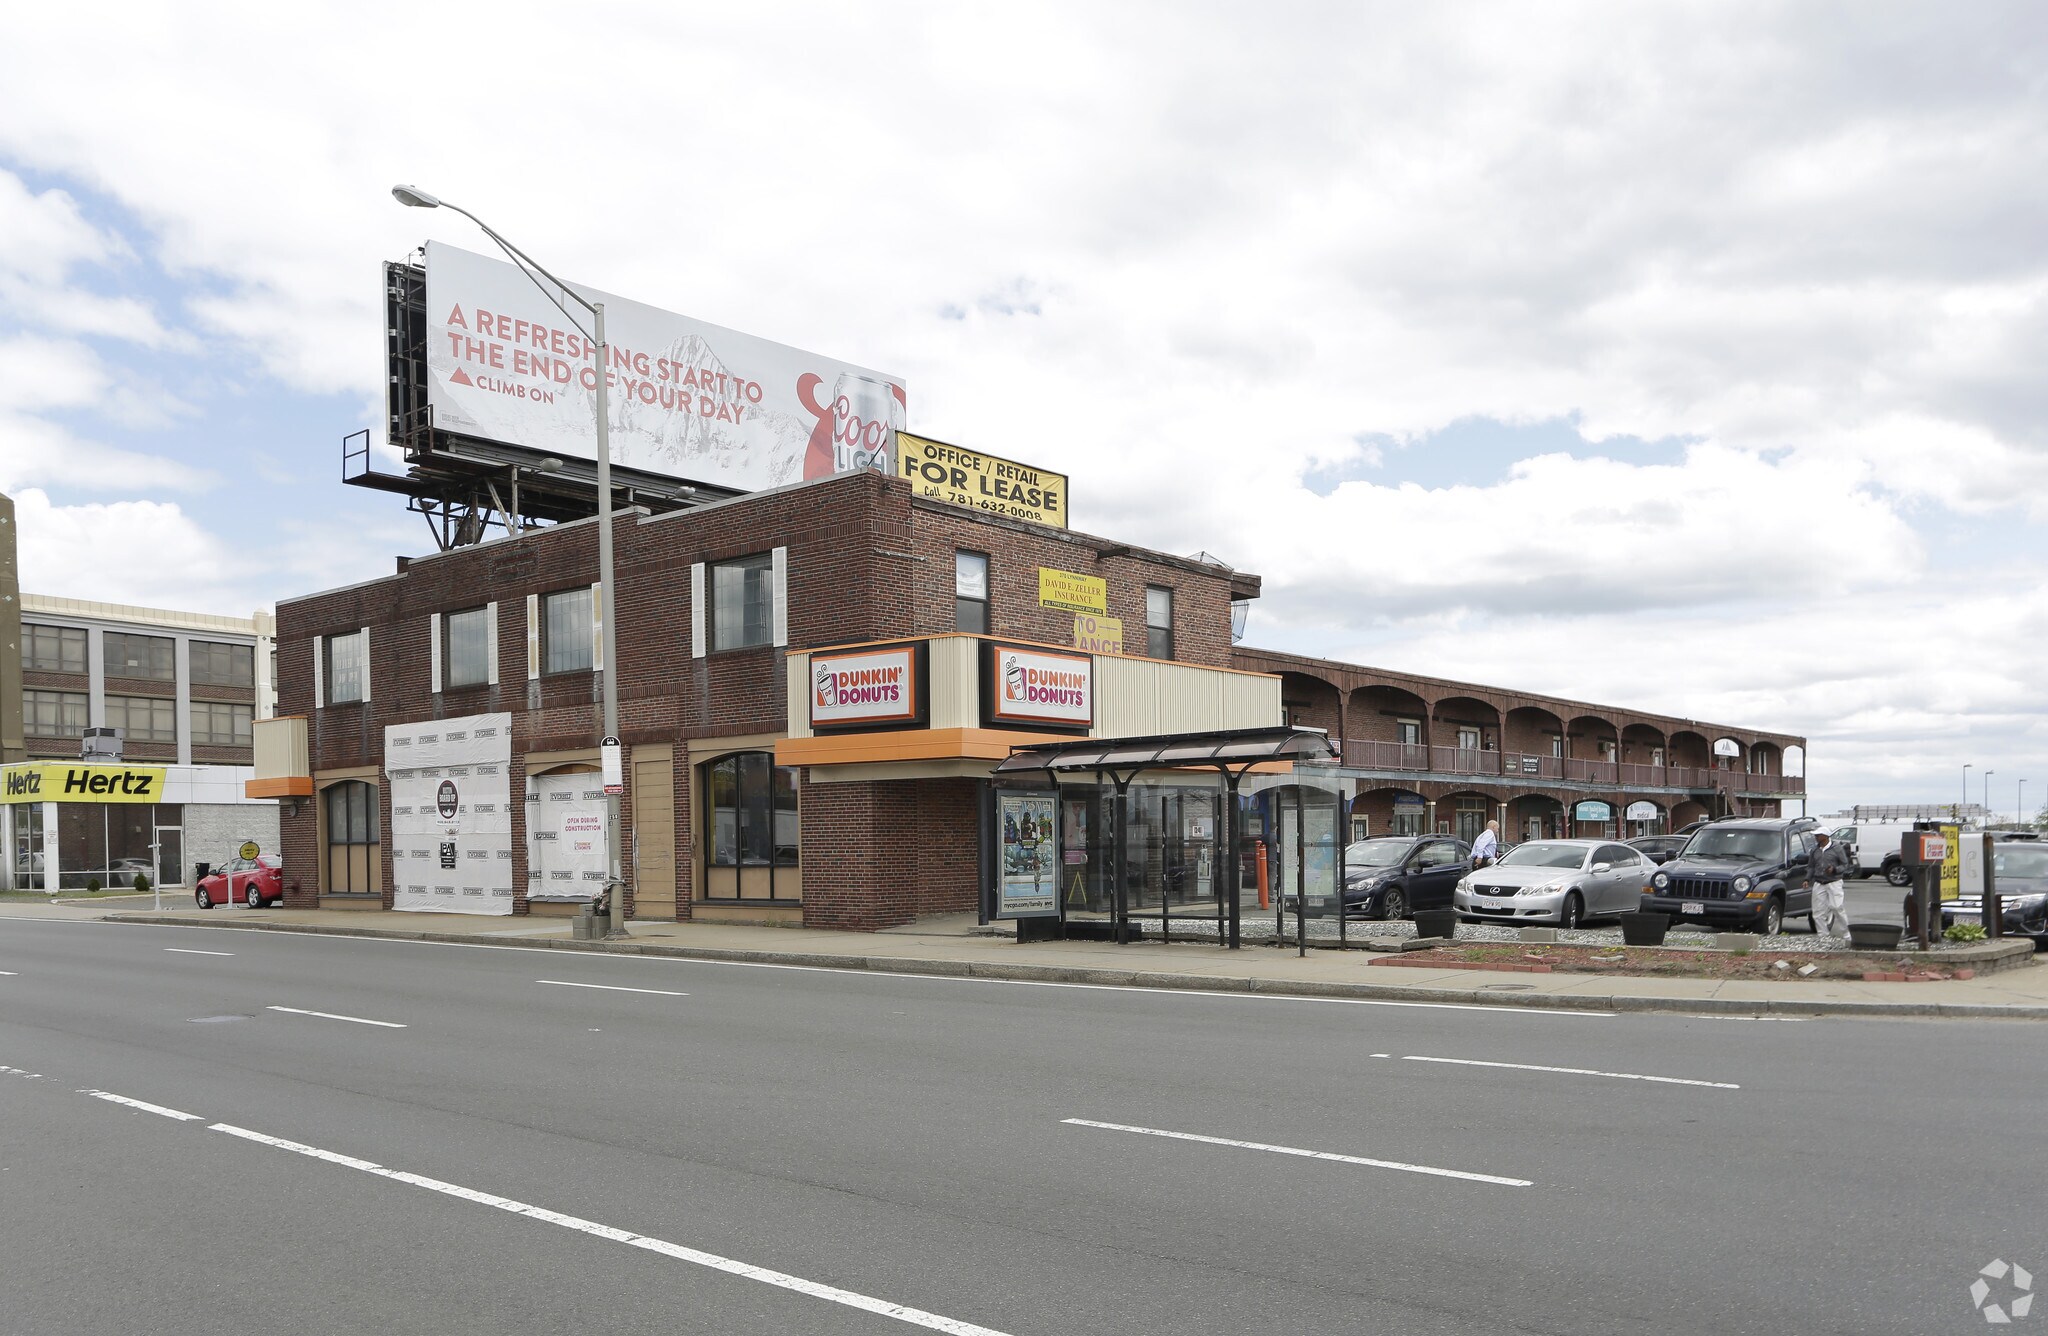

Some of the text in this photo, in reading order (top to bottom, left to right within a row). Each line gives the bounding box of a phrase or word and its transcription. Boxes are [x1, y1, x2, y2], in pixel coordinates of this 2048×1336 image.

[447, 303, 763, 404] A REFRESHING START TO
[447, 331, 504, 369] THE
[513, 349, 571, 384] END
[621, 376, 691, 414] YOUR
[700, 395, 744, 425] DAY
[476, 375, 554, 405] CLIMB ON
[838, 446, 885, 473] LIGH
[923, 445, 980, 471] OFFICE
[997, 462, 1039, 487] RETAIL
[905, 455, 1057, 512] FOR LEASE
[924, 485, 1042, 521] Call 781-632-0008
[1045, 578, 1101, 596] DAVID E. ZELLER
[1054, 590, 1093, 604] INSURANCE
[1075, 615, 1096, 634] TO
[839, 666, 903, 688] DUNKIN'
[1028, 668, 1086, 690] DUNKIN'
[839, 684, 899, 705] DONUTS
[1028, 686, 1083, 706] DONUTS
[7, 770, 41, 795] Hertz
[64, 769, 153, 795] Hertz
